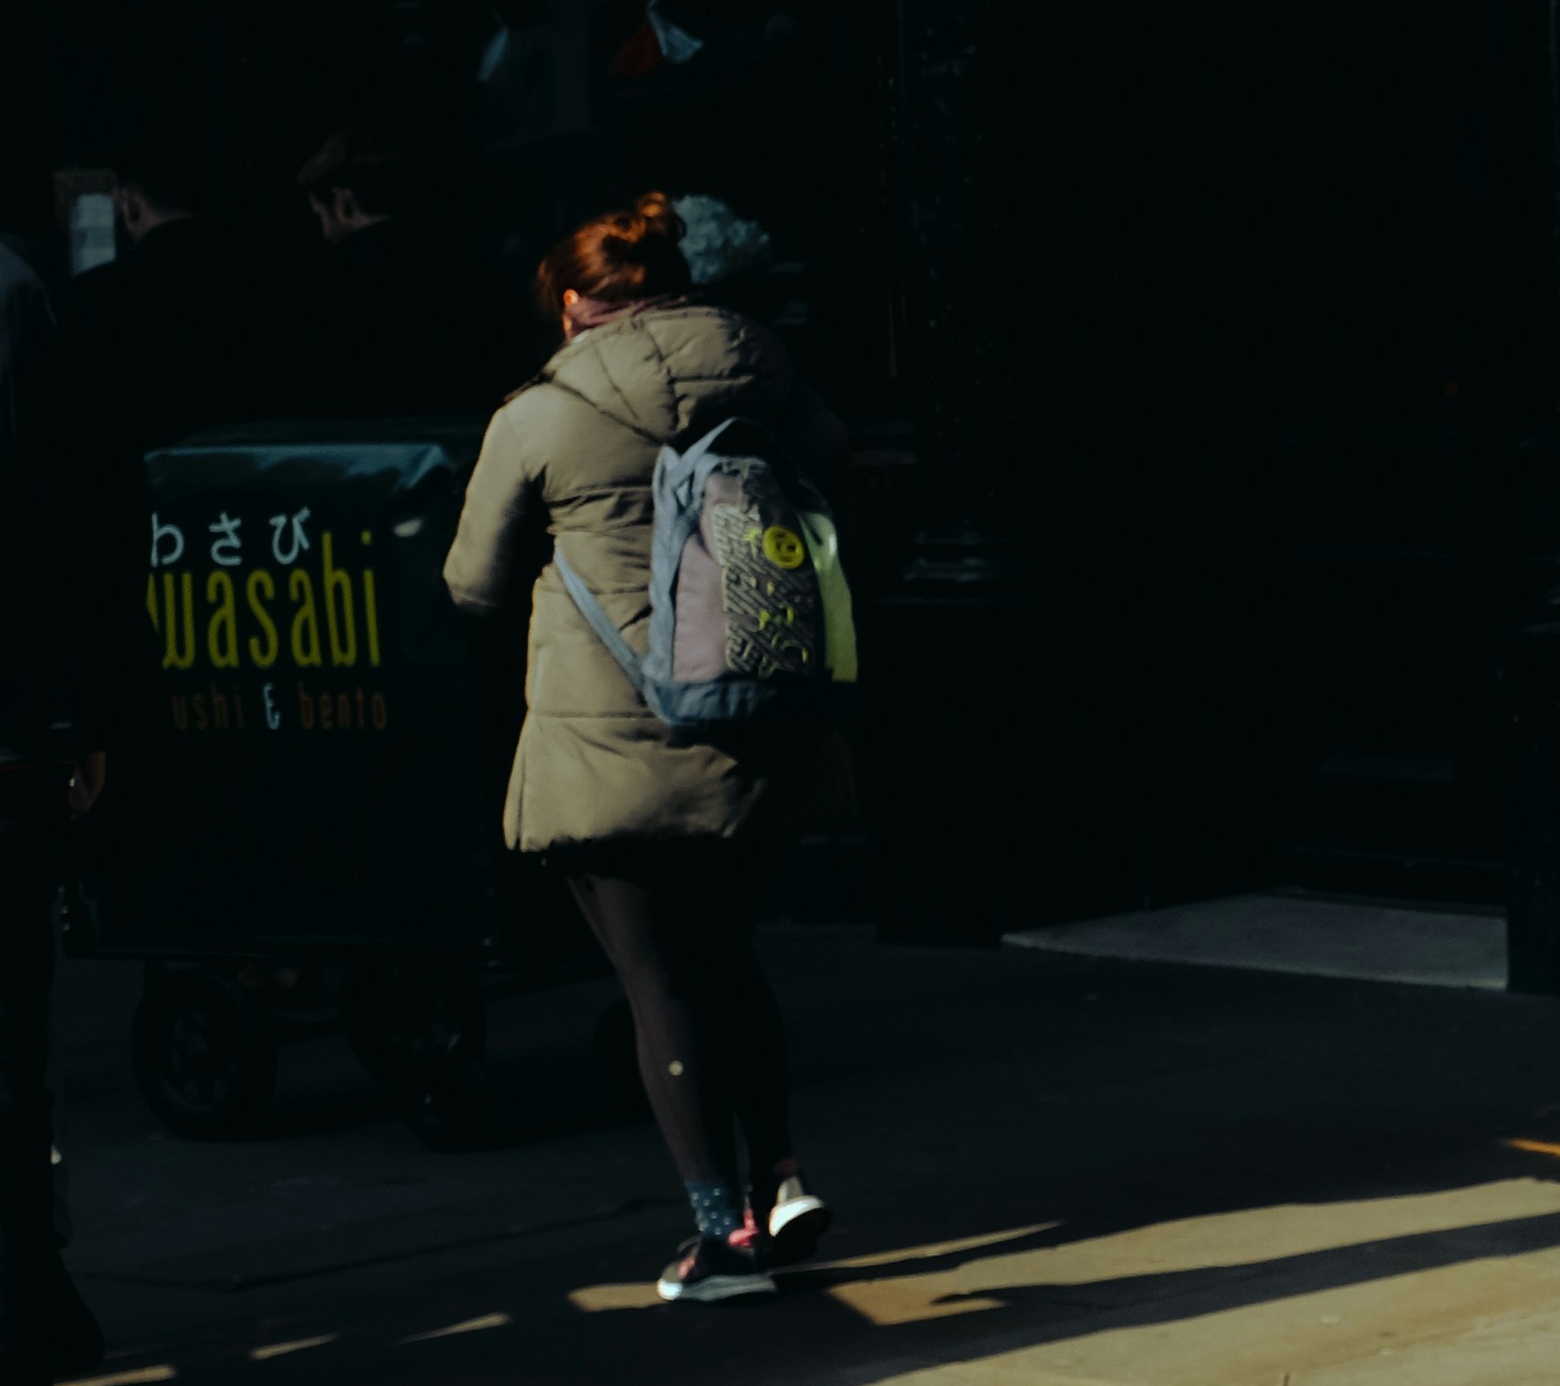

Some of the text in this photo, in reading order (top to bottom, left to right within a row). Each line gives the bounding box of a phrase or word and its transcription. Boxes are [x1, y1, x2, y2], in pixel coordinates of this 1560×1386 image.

[145, 528, 382, 672] wasabi
[170, 680, 247, 731] ushi
[297, 680, 388, 732] bento
